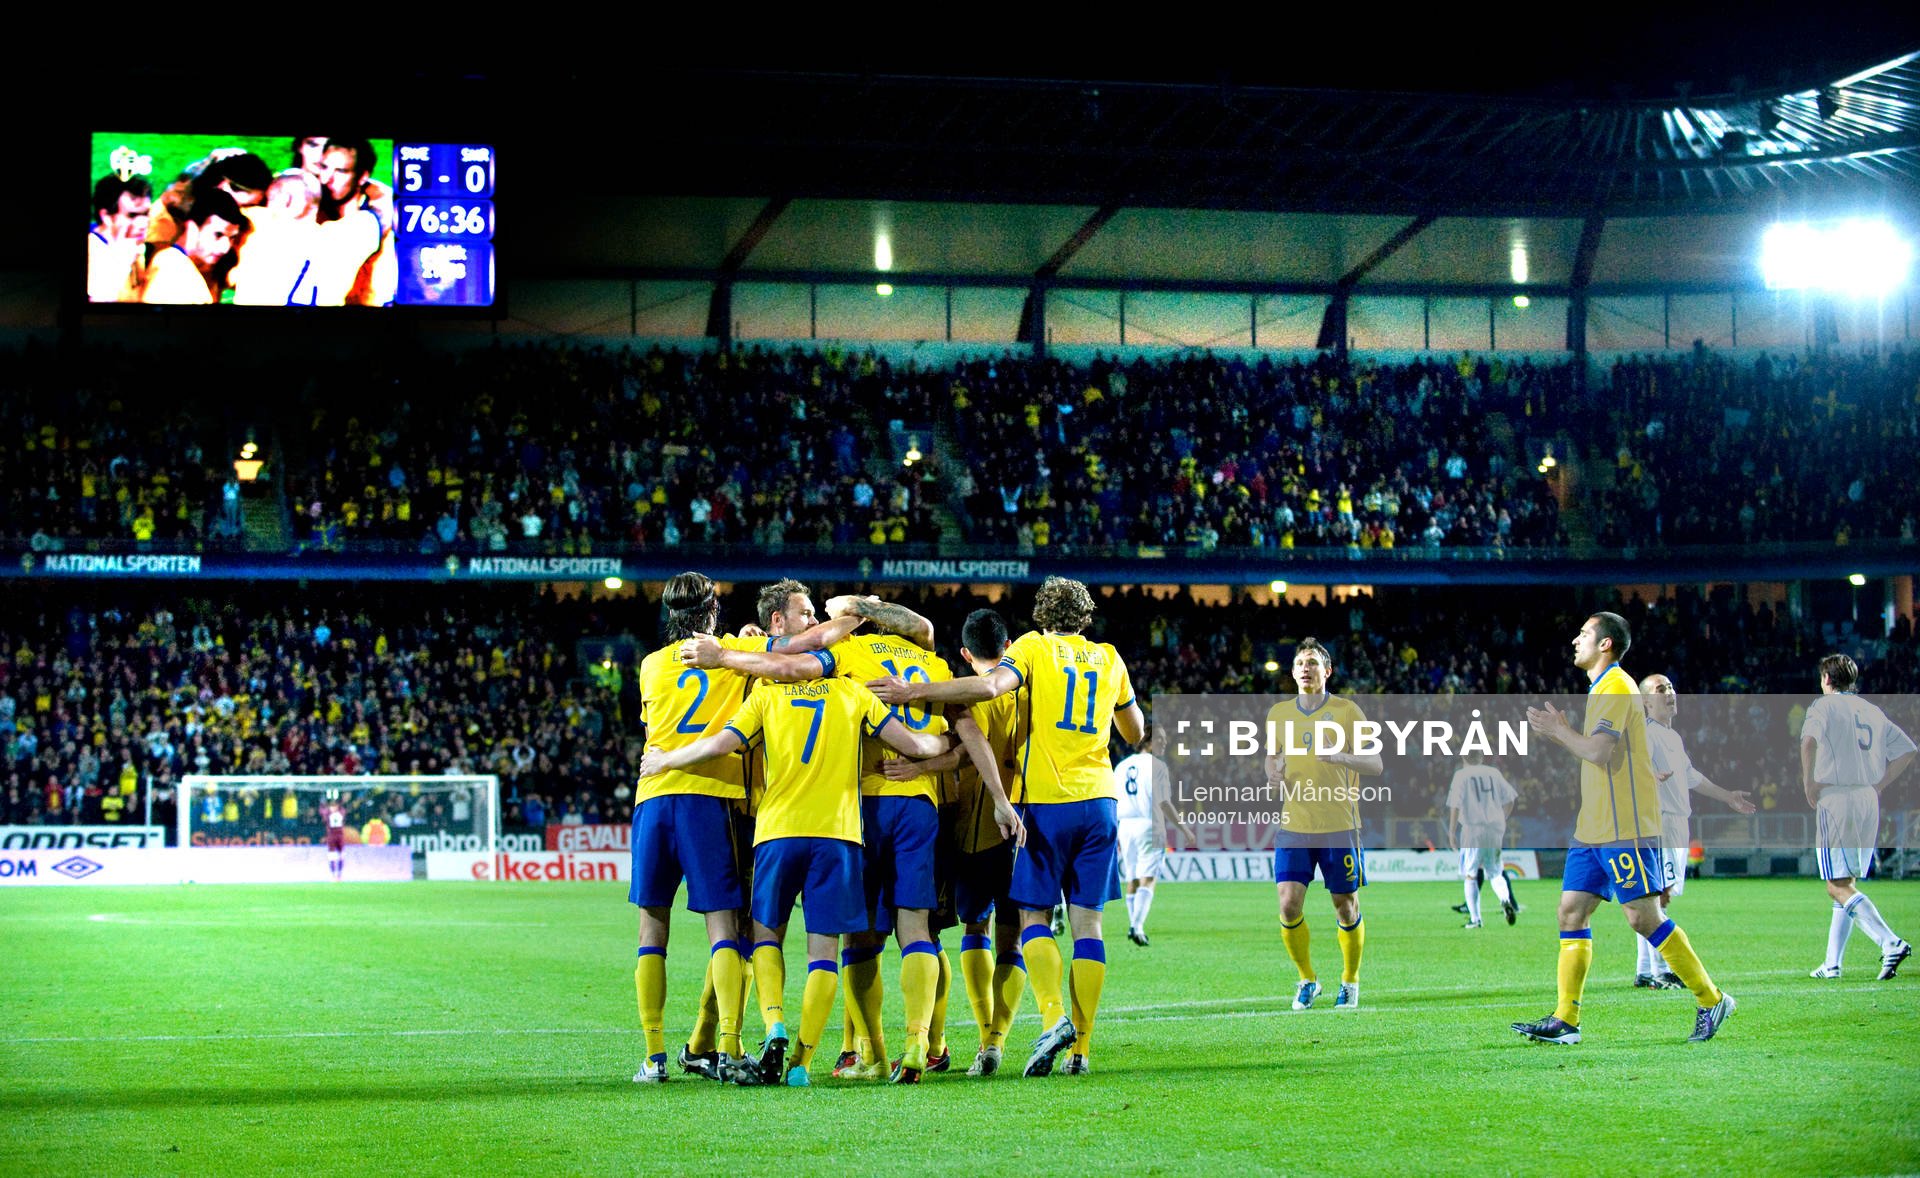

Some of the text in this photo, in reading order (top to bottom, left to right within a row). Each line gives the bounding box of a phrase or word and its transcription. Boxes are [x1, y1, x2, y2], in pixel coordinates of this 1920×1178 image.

[405, 164, 422, 192] 5
[465, 164, 485, 193] 0
[403, 204, 485, 235] 76:36
[45, 555, 201, 573] NATIONALSPORTEN
[469, 557, 622, 575] NATIONALSPORTEN
[882, 560, 1029, 578] NATIONALSPORTEN
[676, 668, 710, 734] 2
[784, 683, 830, 697] LARSSON
[1056, 666, 1098, 735] 11
[791, 698, 826, 765] 7
[1302, 731, 1313, 753] 9
[1854, 709, 1873, 751] 5
[1125, 765, 1139, 796] 8
[1470, 775, 1495, 803] 14
[1343, 854, 1355, 876] 9
[1608, 852, 1636, 884] 19
[1664, 861, 1676, 881] 3
